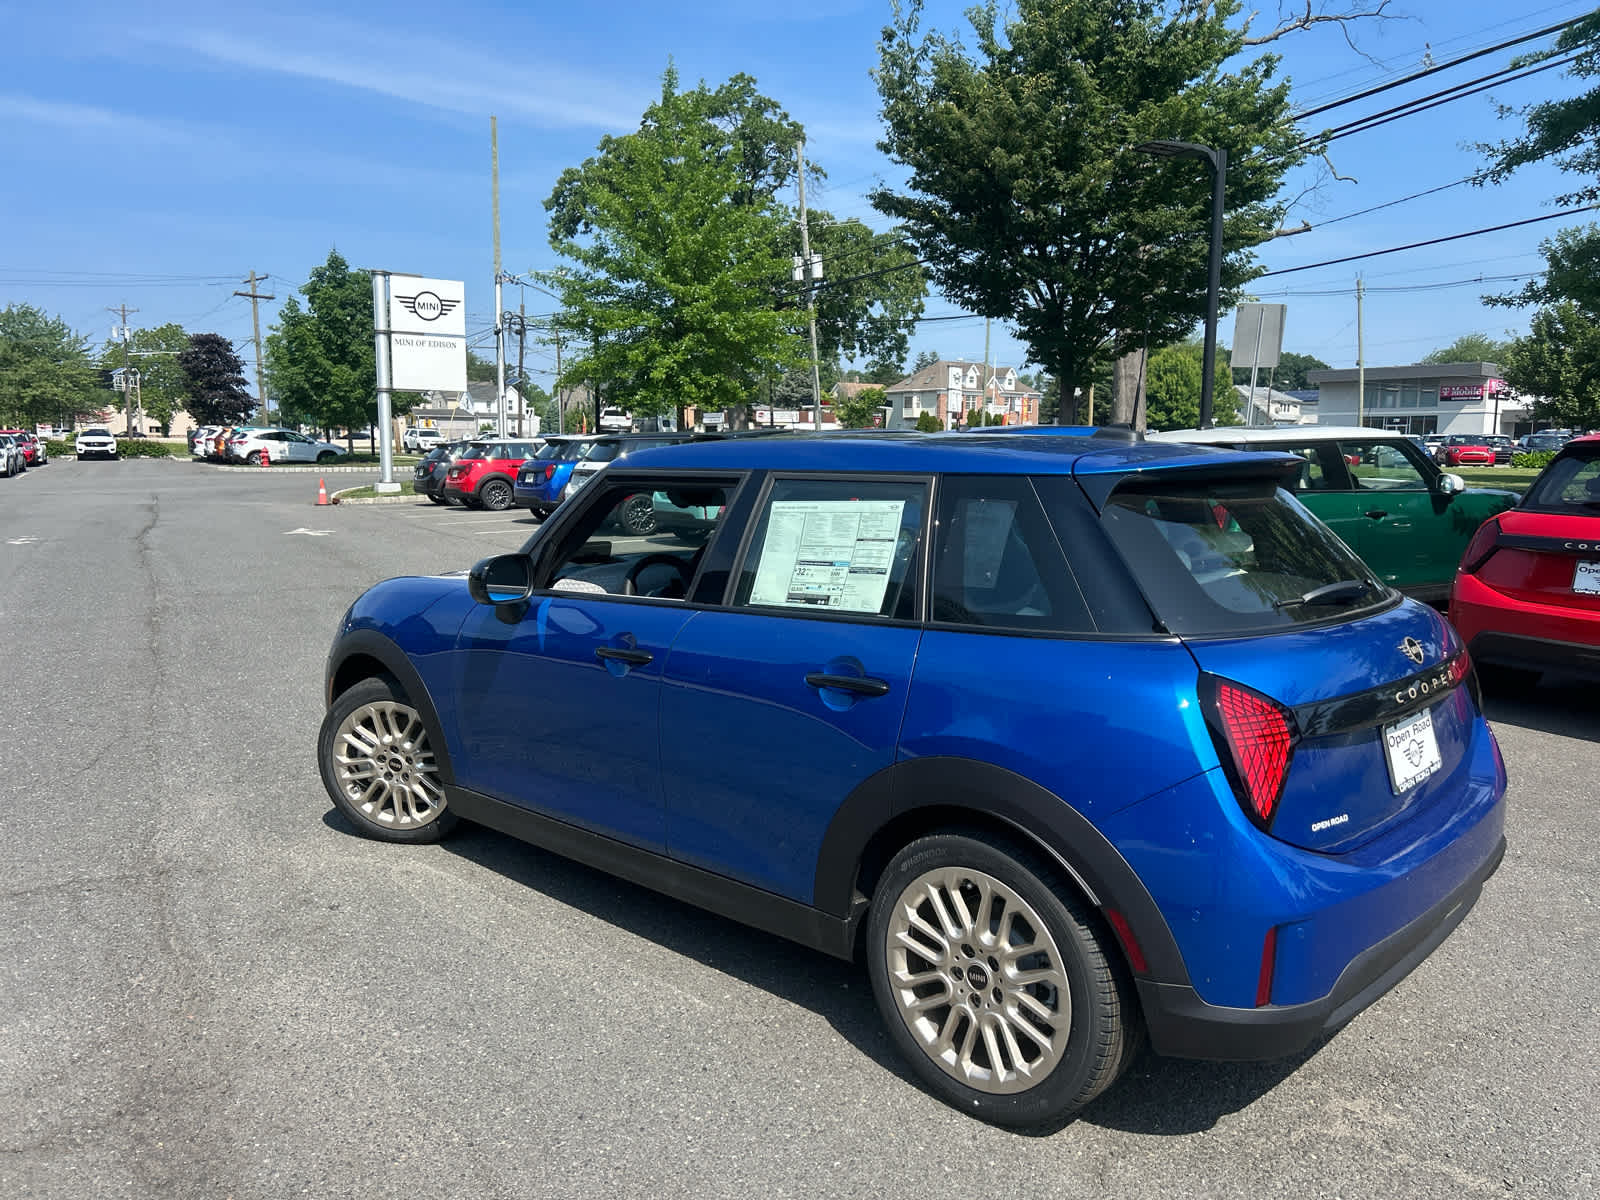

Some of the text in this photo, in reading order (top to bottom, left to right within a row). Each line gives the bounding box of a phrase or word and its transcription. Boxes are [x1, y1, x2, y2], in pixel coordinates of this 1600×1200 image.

[417, 301, 439, 311] MINI
[394, 338, 413, 347] MINI
[428, 340, 456, 349] EDISON
[1396, 670, 1454, 704] COOPER
[1388, 719, 1431, 748] Open Road
[1311, 813, 1349, 832] OPEN ROAD
[969, 971, 986, 983] MINI
